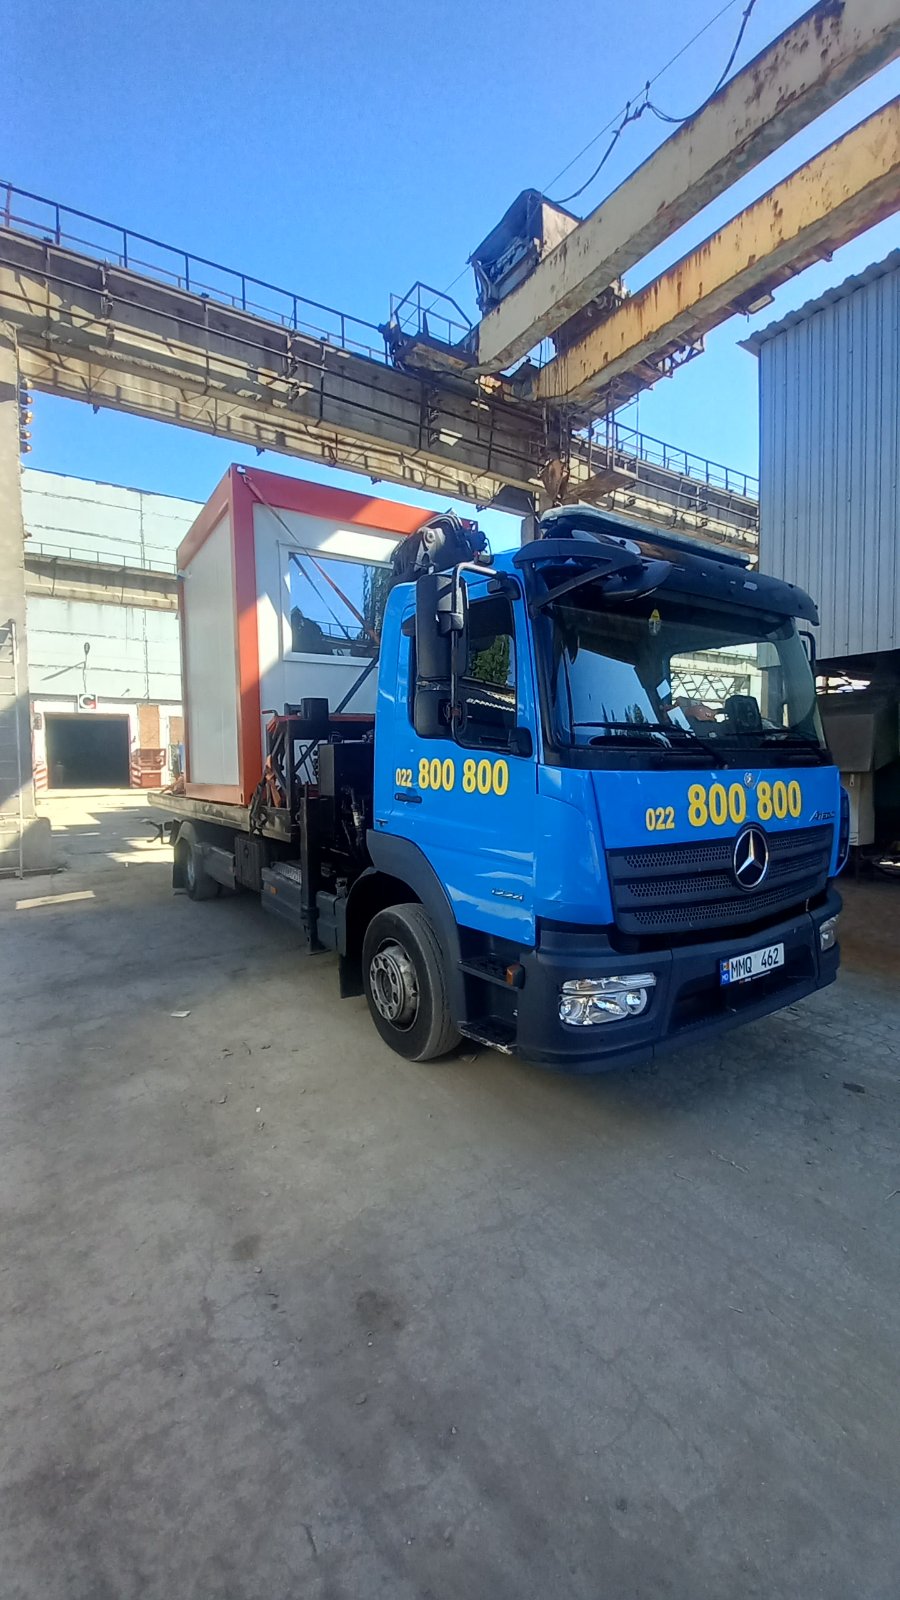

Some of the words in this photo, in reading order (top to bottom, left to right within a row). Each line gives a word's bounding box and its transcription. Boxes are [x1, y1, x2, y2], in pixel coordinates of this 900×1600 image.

[395, 767, 413, 787] 022
[418, 757, 455, 791] 800
[462, 758, 509, 795] 800
[645, 806, 675, 831] 022
[687, 783, 747, 827] 800
[756, 780, 802, 820] 800
[730, 956, 752, 980] MMQ
[761, 947, 779, 968] 462
